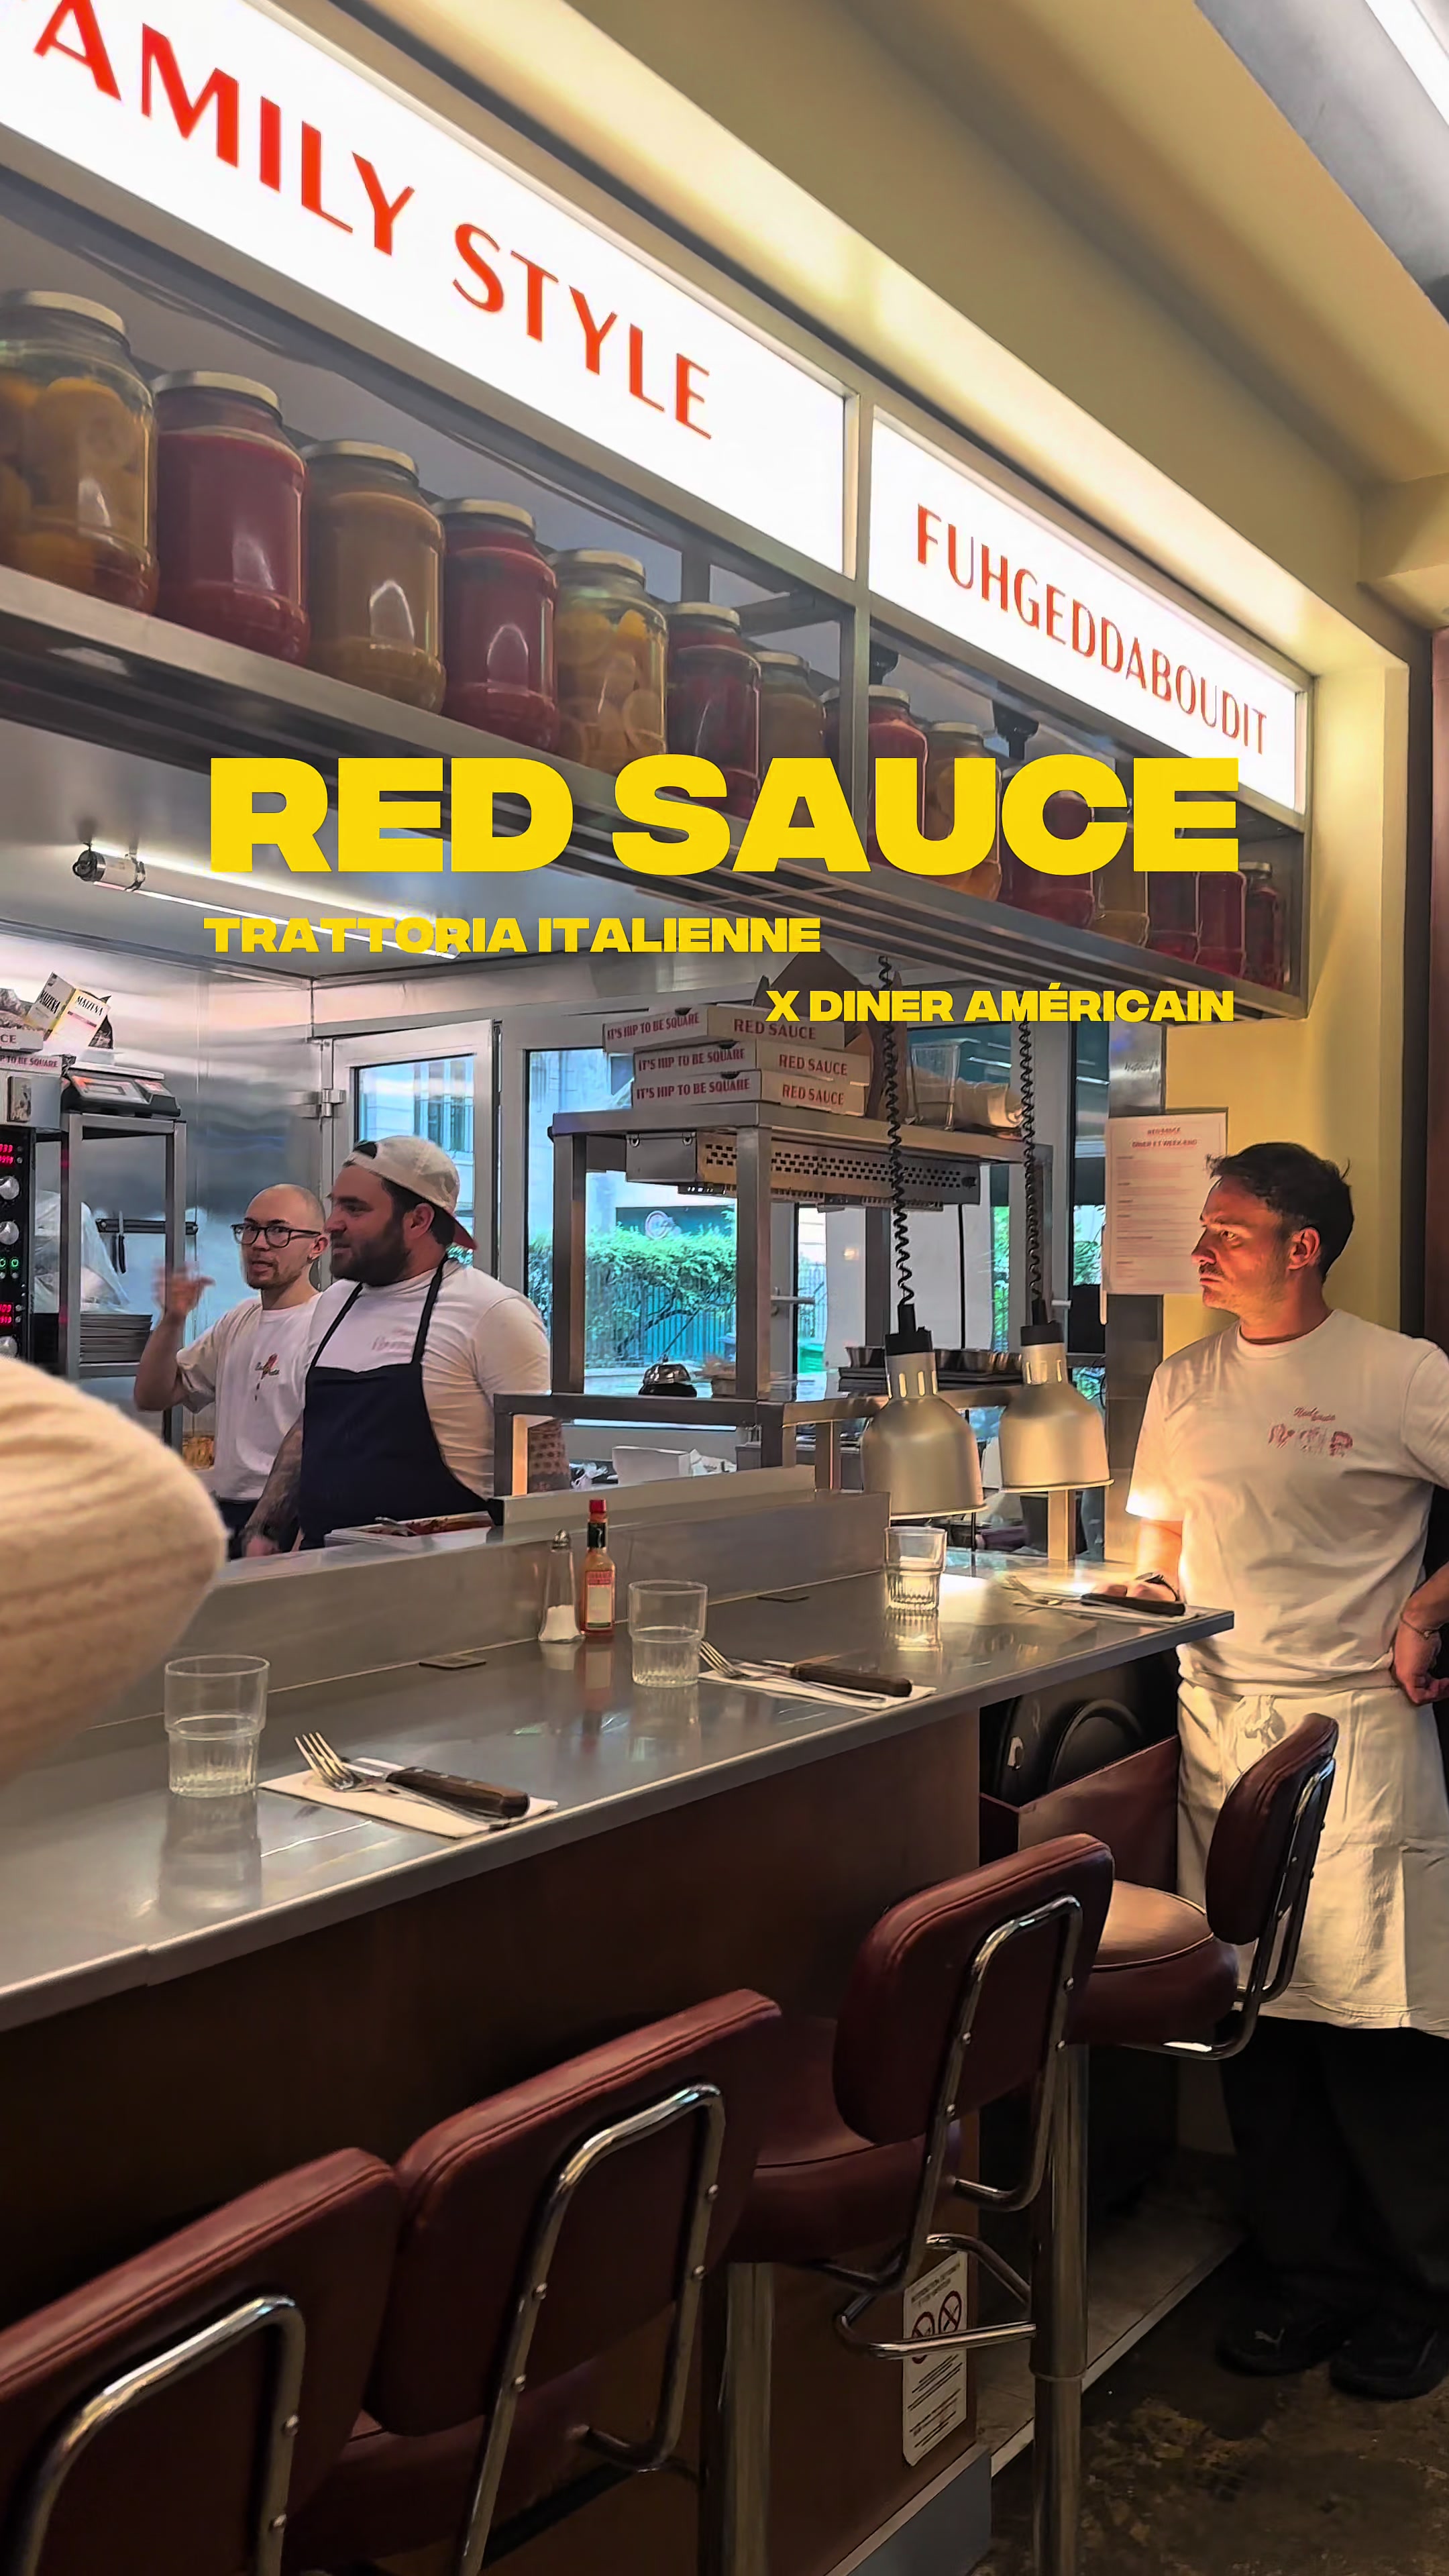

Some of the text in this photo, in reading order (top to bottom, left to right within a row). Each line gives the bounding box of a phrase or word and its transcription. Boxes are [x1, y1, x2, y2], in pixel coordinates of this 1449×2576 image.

[22, 0, 711, 439] AMILY STYLE
[917, 503, 1267, 755] FUHGEDDABOUDIT
[607, 1027, 623, 1040] IT'S
[641, 1022, 651, 1034] TO
[653, 1018, 664, 1032] BE
[666, 1012, 700, 1030] SQUARE
[734, 1018, 816, 1040] RED SAUCE
[639, 1058, 655, 1071] IT'S
[678, 1055, 690, 1067] TO
[692, 1053, 704, 1065] BE
[707, 1048, 745, 1063] SQUARE
[779, 1054, 847, 1076] RED SAUCE
[637, 1087, 655, 1099] IT'S
[678, 1084, 690, 1096] TO
[693, 1083, 706, 1094] BE
[709, 1078, 750, 1093] SQUARE
[782, 1084, 845, 1106] RED SAUCE
